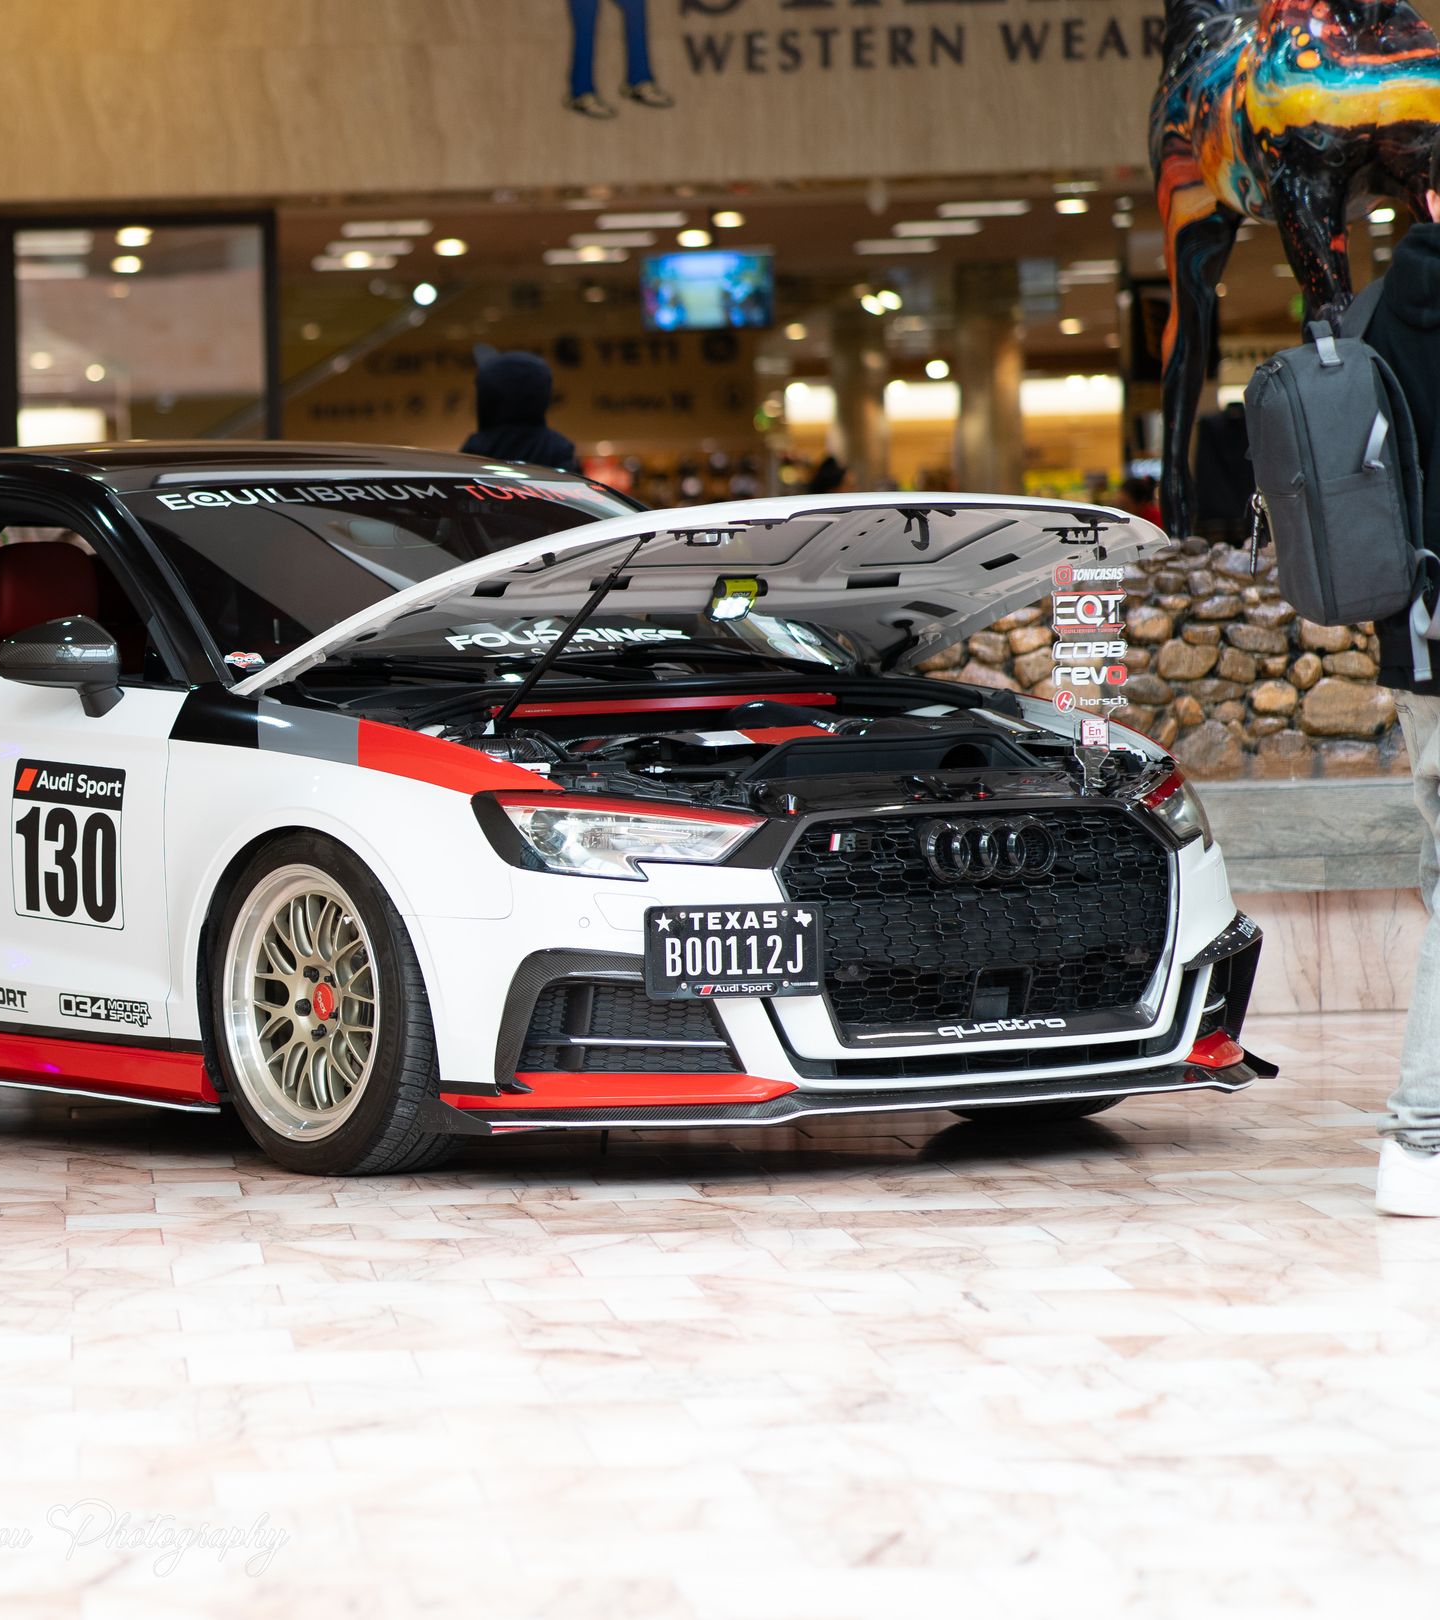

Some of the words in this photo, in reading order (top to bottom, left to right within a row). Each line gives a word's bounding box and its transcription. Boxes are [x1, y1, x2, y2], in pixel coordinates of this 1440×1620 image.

[685, 26, 965, 73] WESTERN
[156, 484, 447, 512] EQUILIBRIUM
[1072, 568, 1124, 581] TONYCASAS
[1056, 594, 1125, 627] EQT
[1054, 641, 1126, 659] COBB
[1055, 666, 1127, 686] revo
[1080, 696, 1127, 706] horsch
[1088, 726, 1101, 736] En
[36, 770, 74, 791] Audi
[76, 774, 122, 798] Sport
[15, 806, 117, 923] 130
[689, 911, 778, 931] TEXAS
[714, 984, 739, 993] Audi
[741, 984, 772, 993] Sport
[60, 994, 108, 1019] 034
[107, 999, 148, 1014] MOTOR
[109, 1011, 150, 1026] SPORT
[937, 1018, 1067, 1039] quattro
